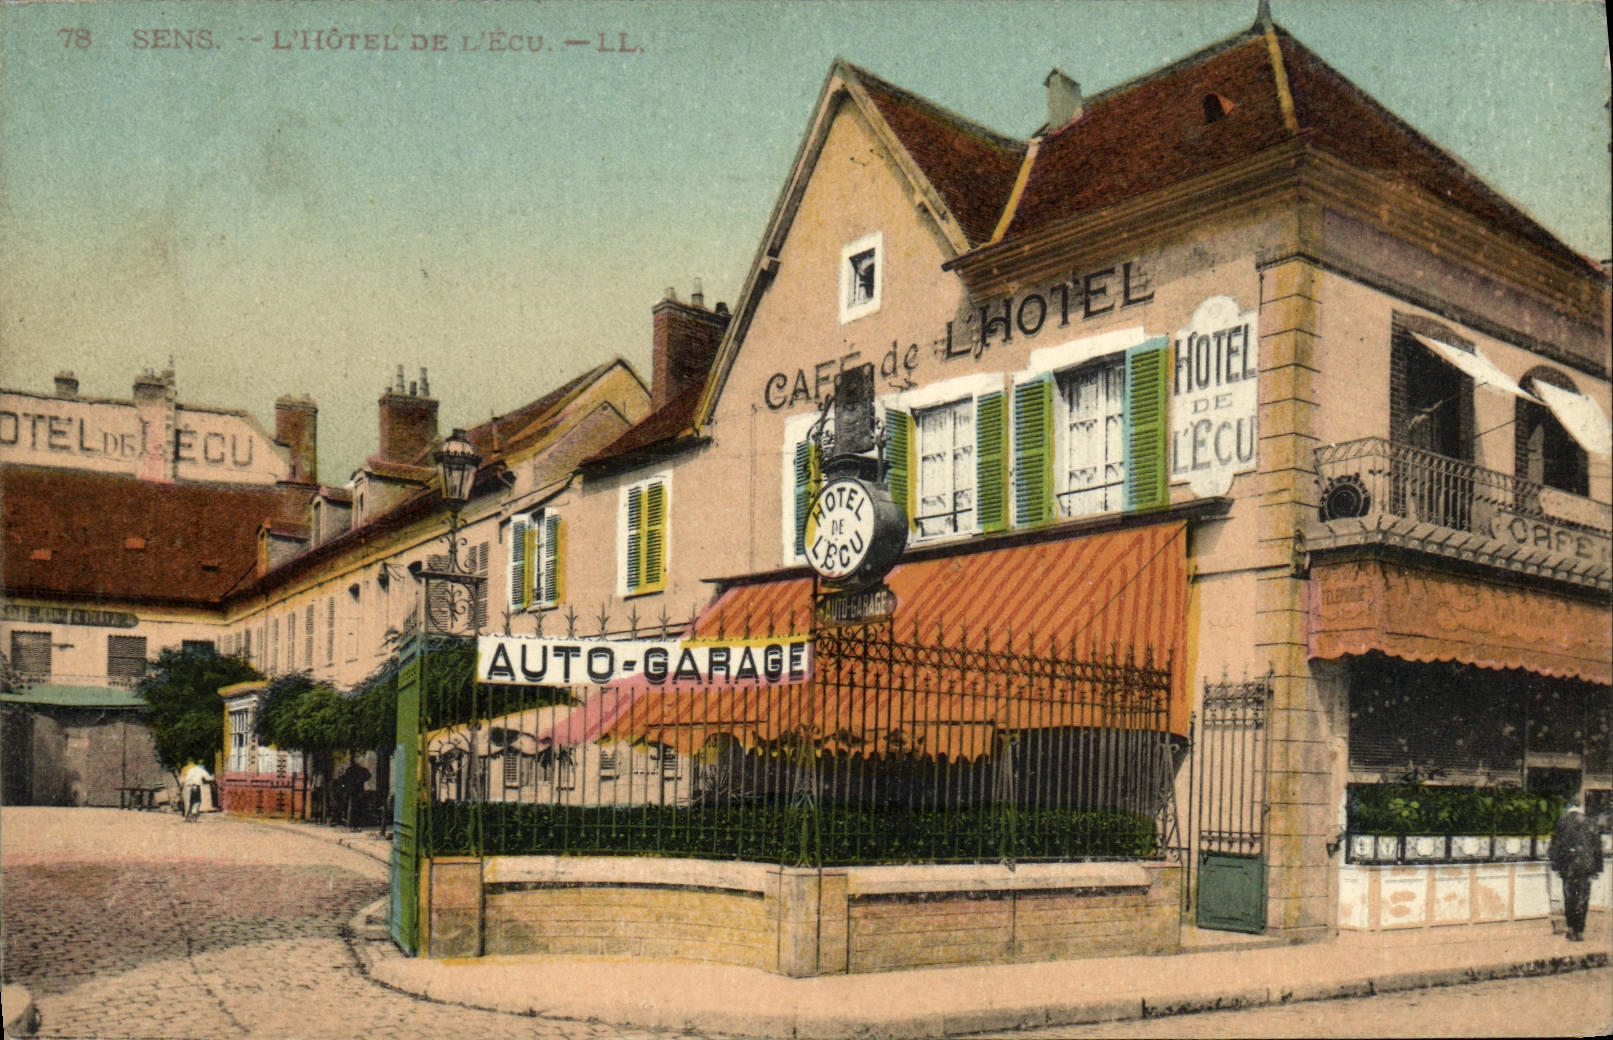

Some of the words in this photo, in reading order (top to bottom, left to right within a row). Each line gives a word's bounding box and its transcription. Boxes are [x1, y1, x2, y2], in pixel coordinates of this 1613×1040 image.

[1191, 393, 1233, 414] DE
[831, 519, 845, 535] DE
[487, 642, 806, 686] AUTO-GARAGE
